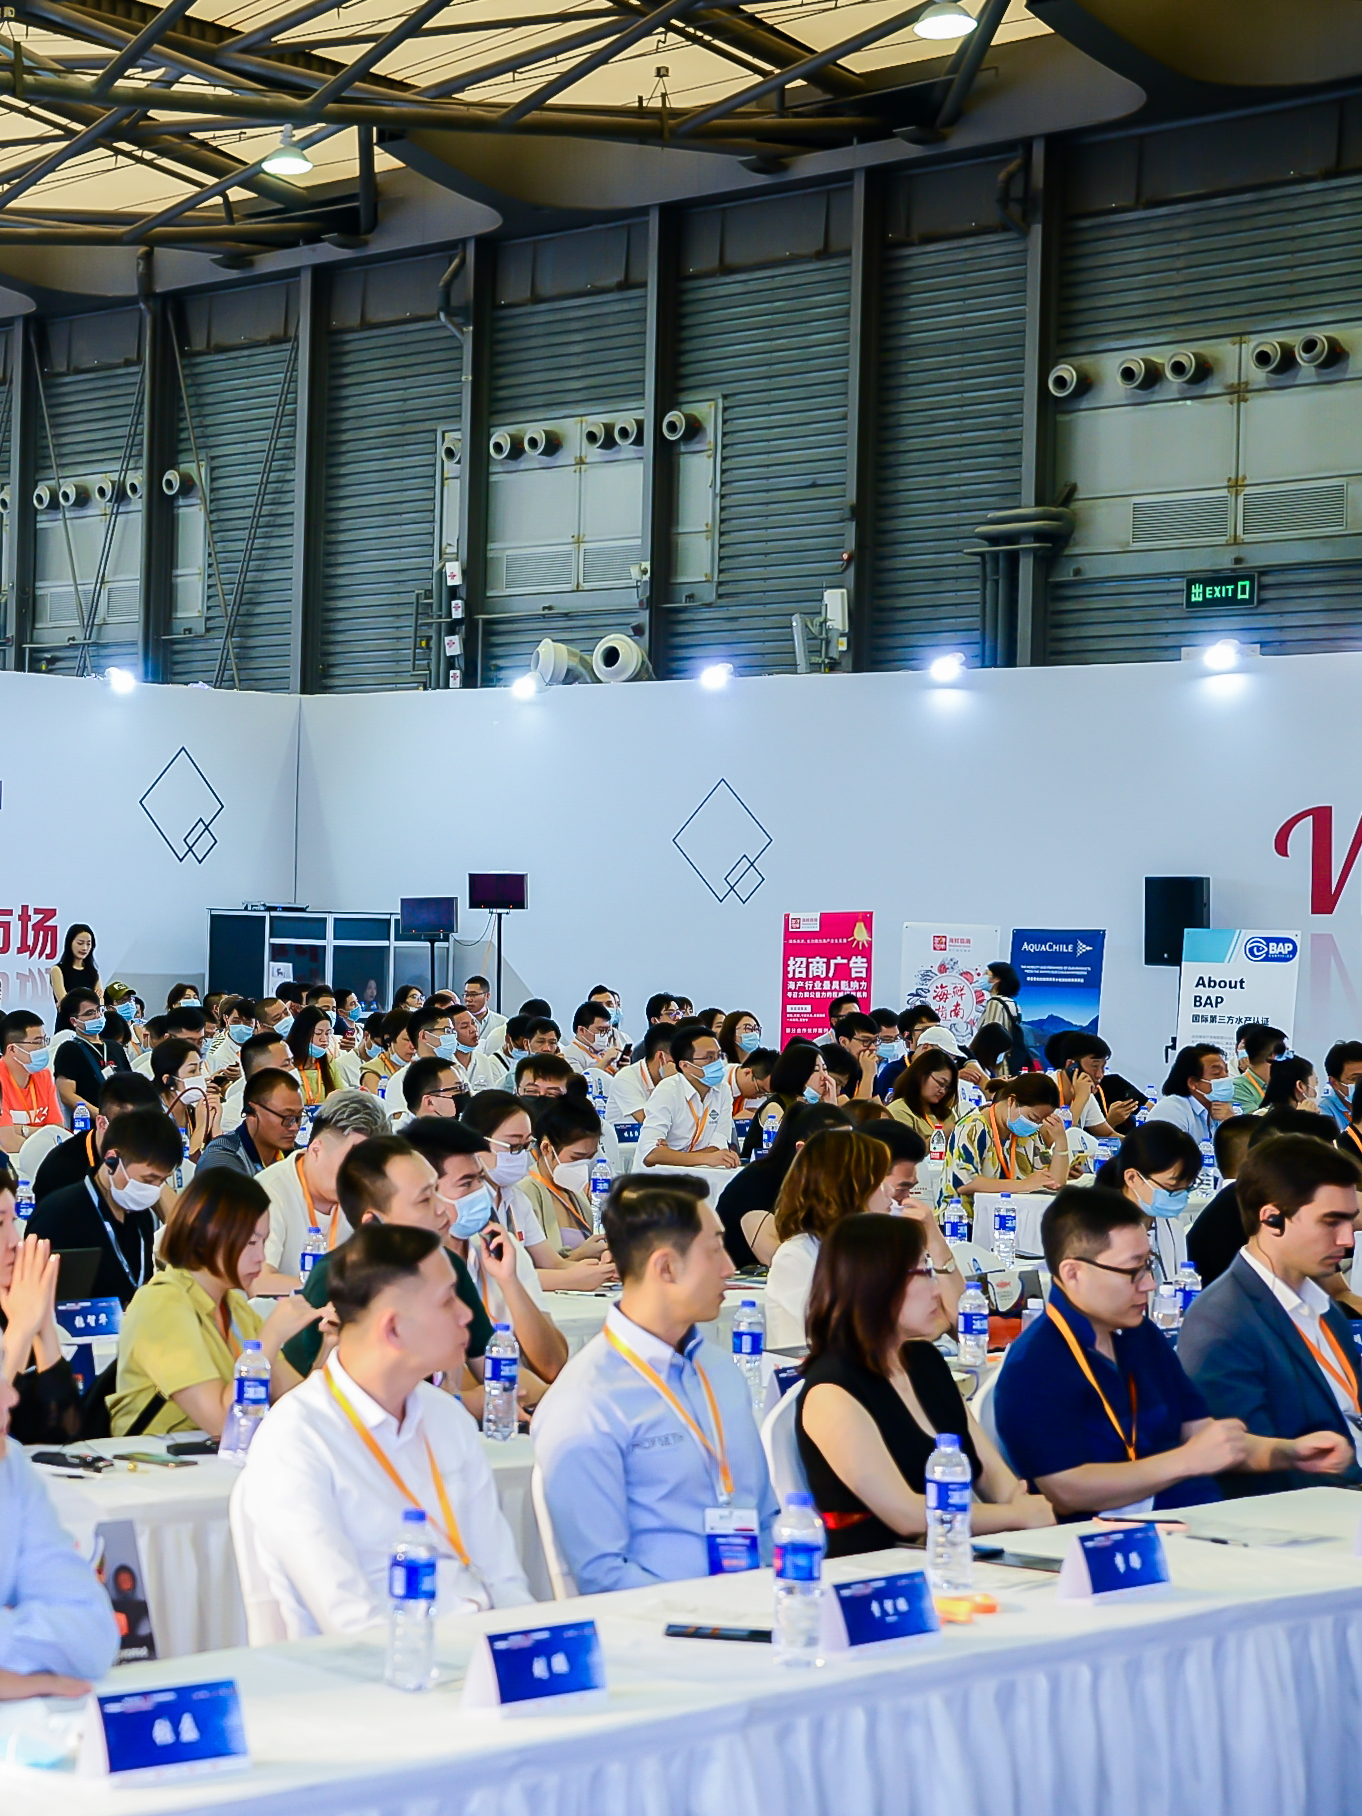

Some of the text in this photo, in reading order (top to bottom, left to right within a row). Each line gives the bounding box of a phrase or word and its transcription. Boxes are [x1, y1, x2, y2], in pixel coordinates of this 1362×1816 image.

[1190, 580, 1250, 602] 出 EXIT 口
[1268, 942, 1294, 955] BAP
[786, 955, 869, 979] 招商广告
[1194, 975, 1246, 990] About
[1193, 994, 1225, 1009] BAP
